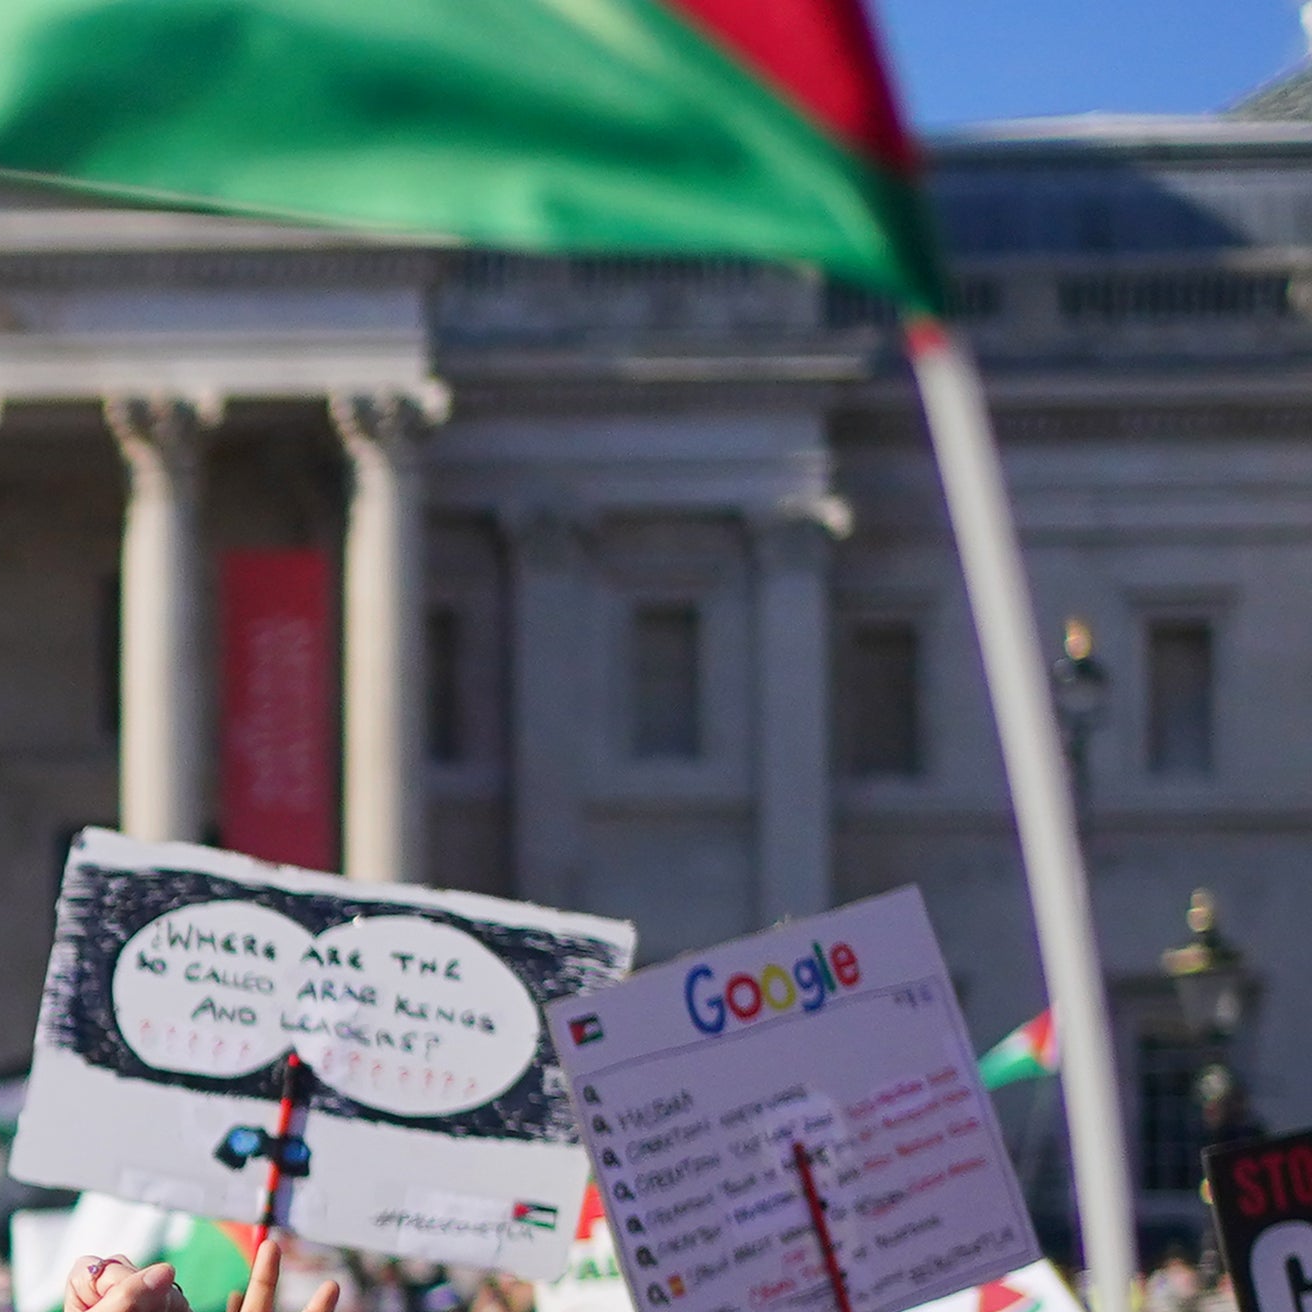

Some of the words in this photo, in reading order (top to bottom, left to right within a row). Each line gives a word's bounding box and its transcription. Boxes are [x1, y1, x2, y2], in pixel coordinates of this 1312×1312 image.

[300, 945, 364, 972] ARE
[390, 951, 462, 981] THE
[184, 962, 274, 993] CALLED
[297, 979, 377, 1006] ARAB
[684, 941, 862, 1035] Google
[191, 997, 257, 1026] AND
